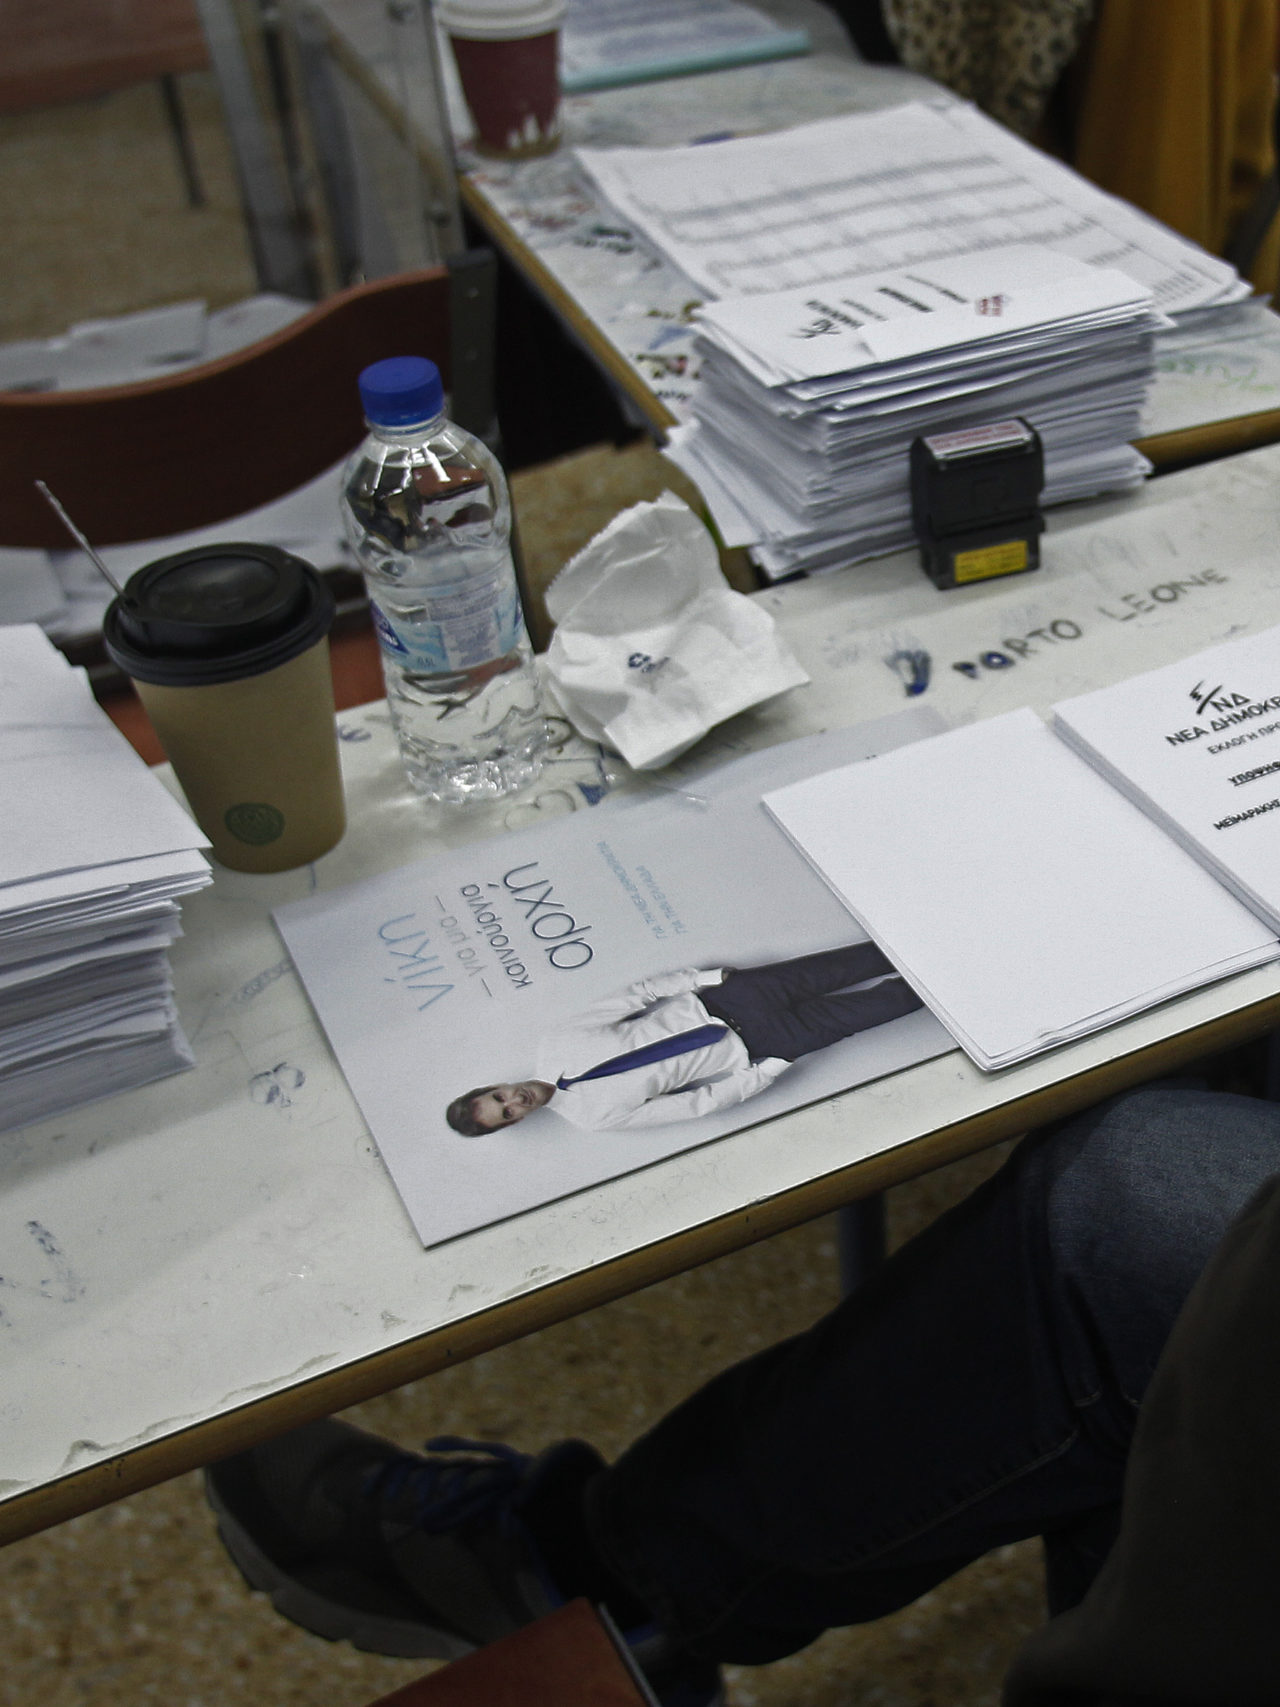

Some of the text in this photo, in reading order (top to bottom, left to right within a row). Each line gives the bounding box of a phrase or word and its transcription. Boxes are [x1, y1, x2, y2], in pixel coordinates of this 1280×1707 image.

[1098, 568, 1230, 622] LEONE
[1165, 724, 1209, 747] ΝΕΑ
[1207, 730, 1258, 755] ΕΚΛΟΓΗ
[440, 915, 488, 978] για μια
[460, 883, 534, 989] καινούργια
[487, 861, 595, 970] αρχή
[377, 912, 455, 1011] νίκη
